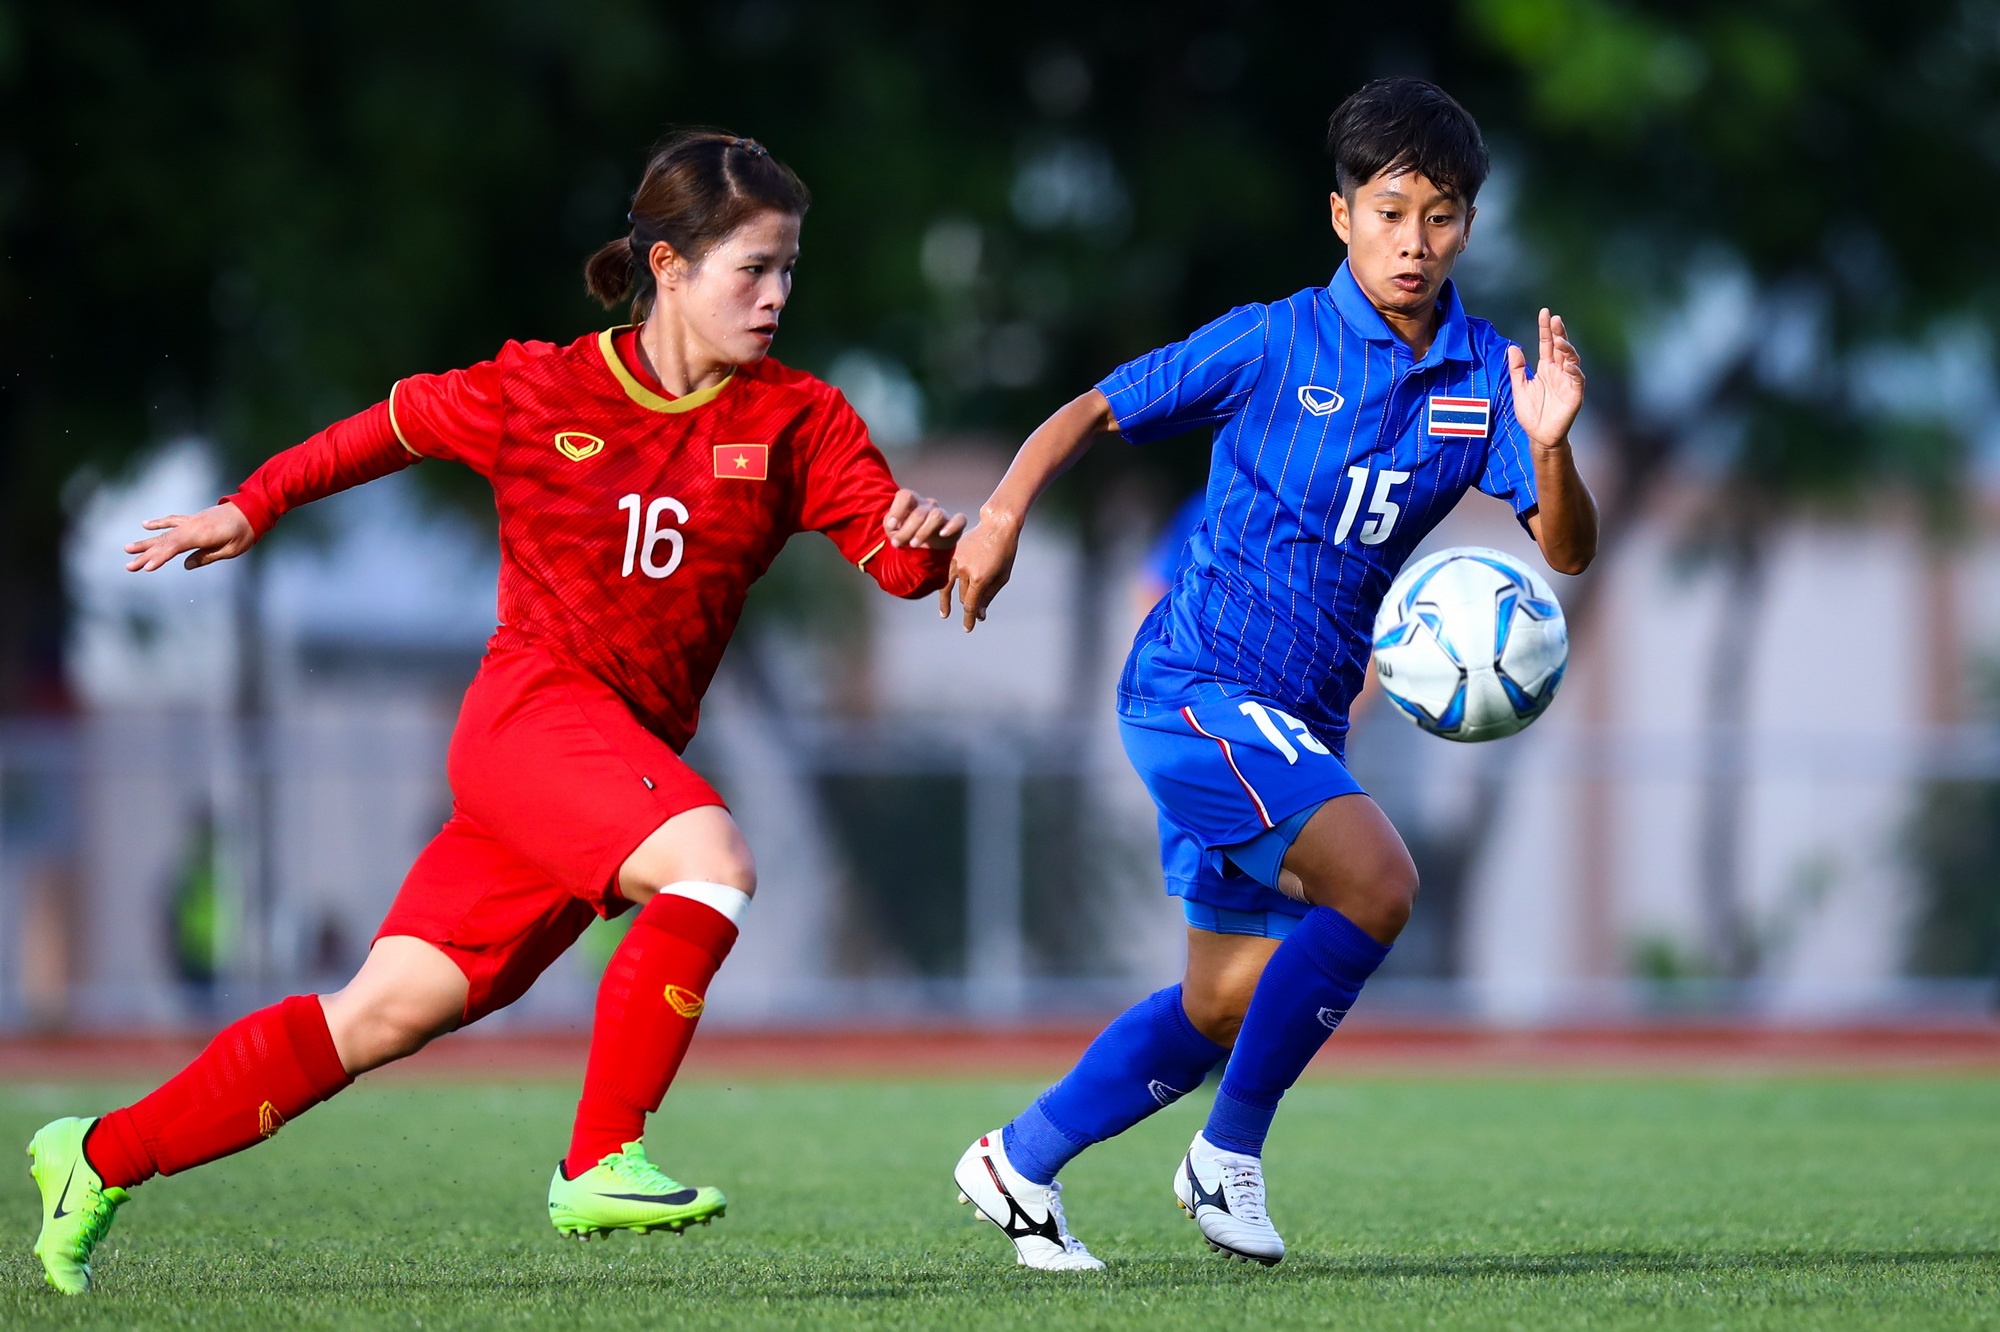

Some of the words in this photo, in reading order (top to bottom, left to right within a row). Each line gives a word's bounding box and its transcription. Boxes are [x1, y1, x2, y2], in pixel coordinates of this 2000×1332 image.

[618, 493, 690, 579] 16
[1333, 465, 1411, 546] 15
[1237, 700, 1331, 766] 15
